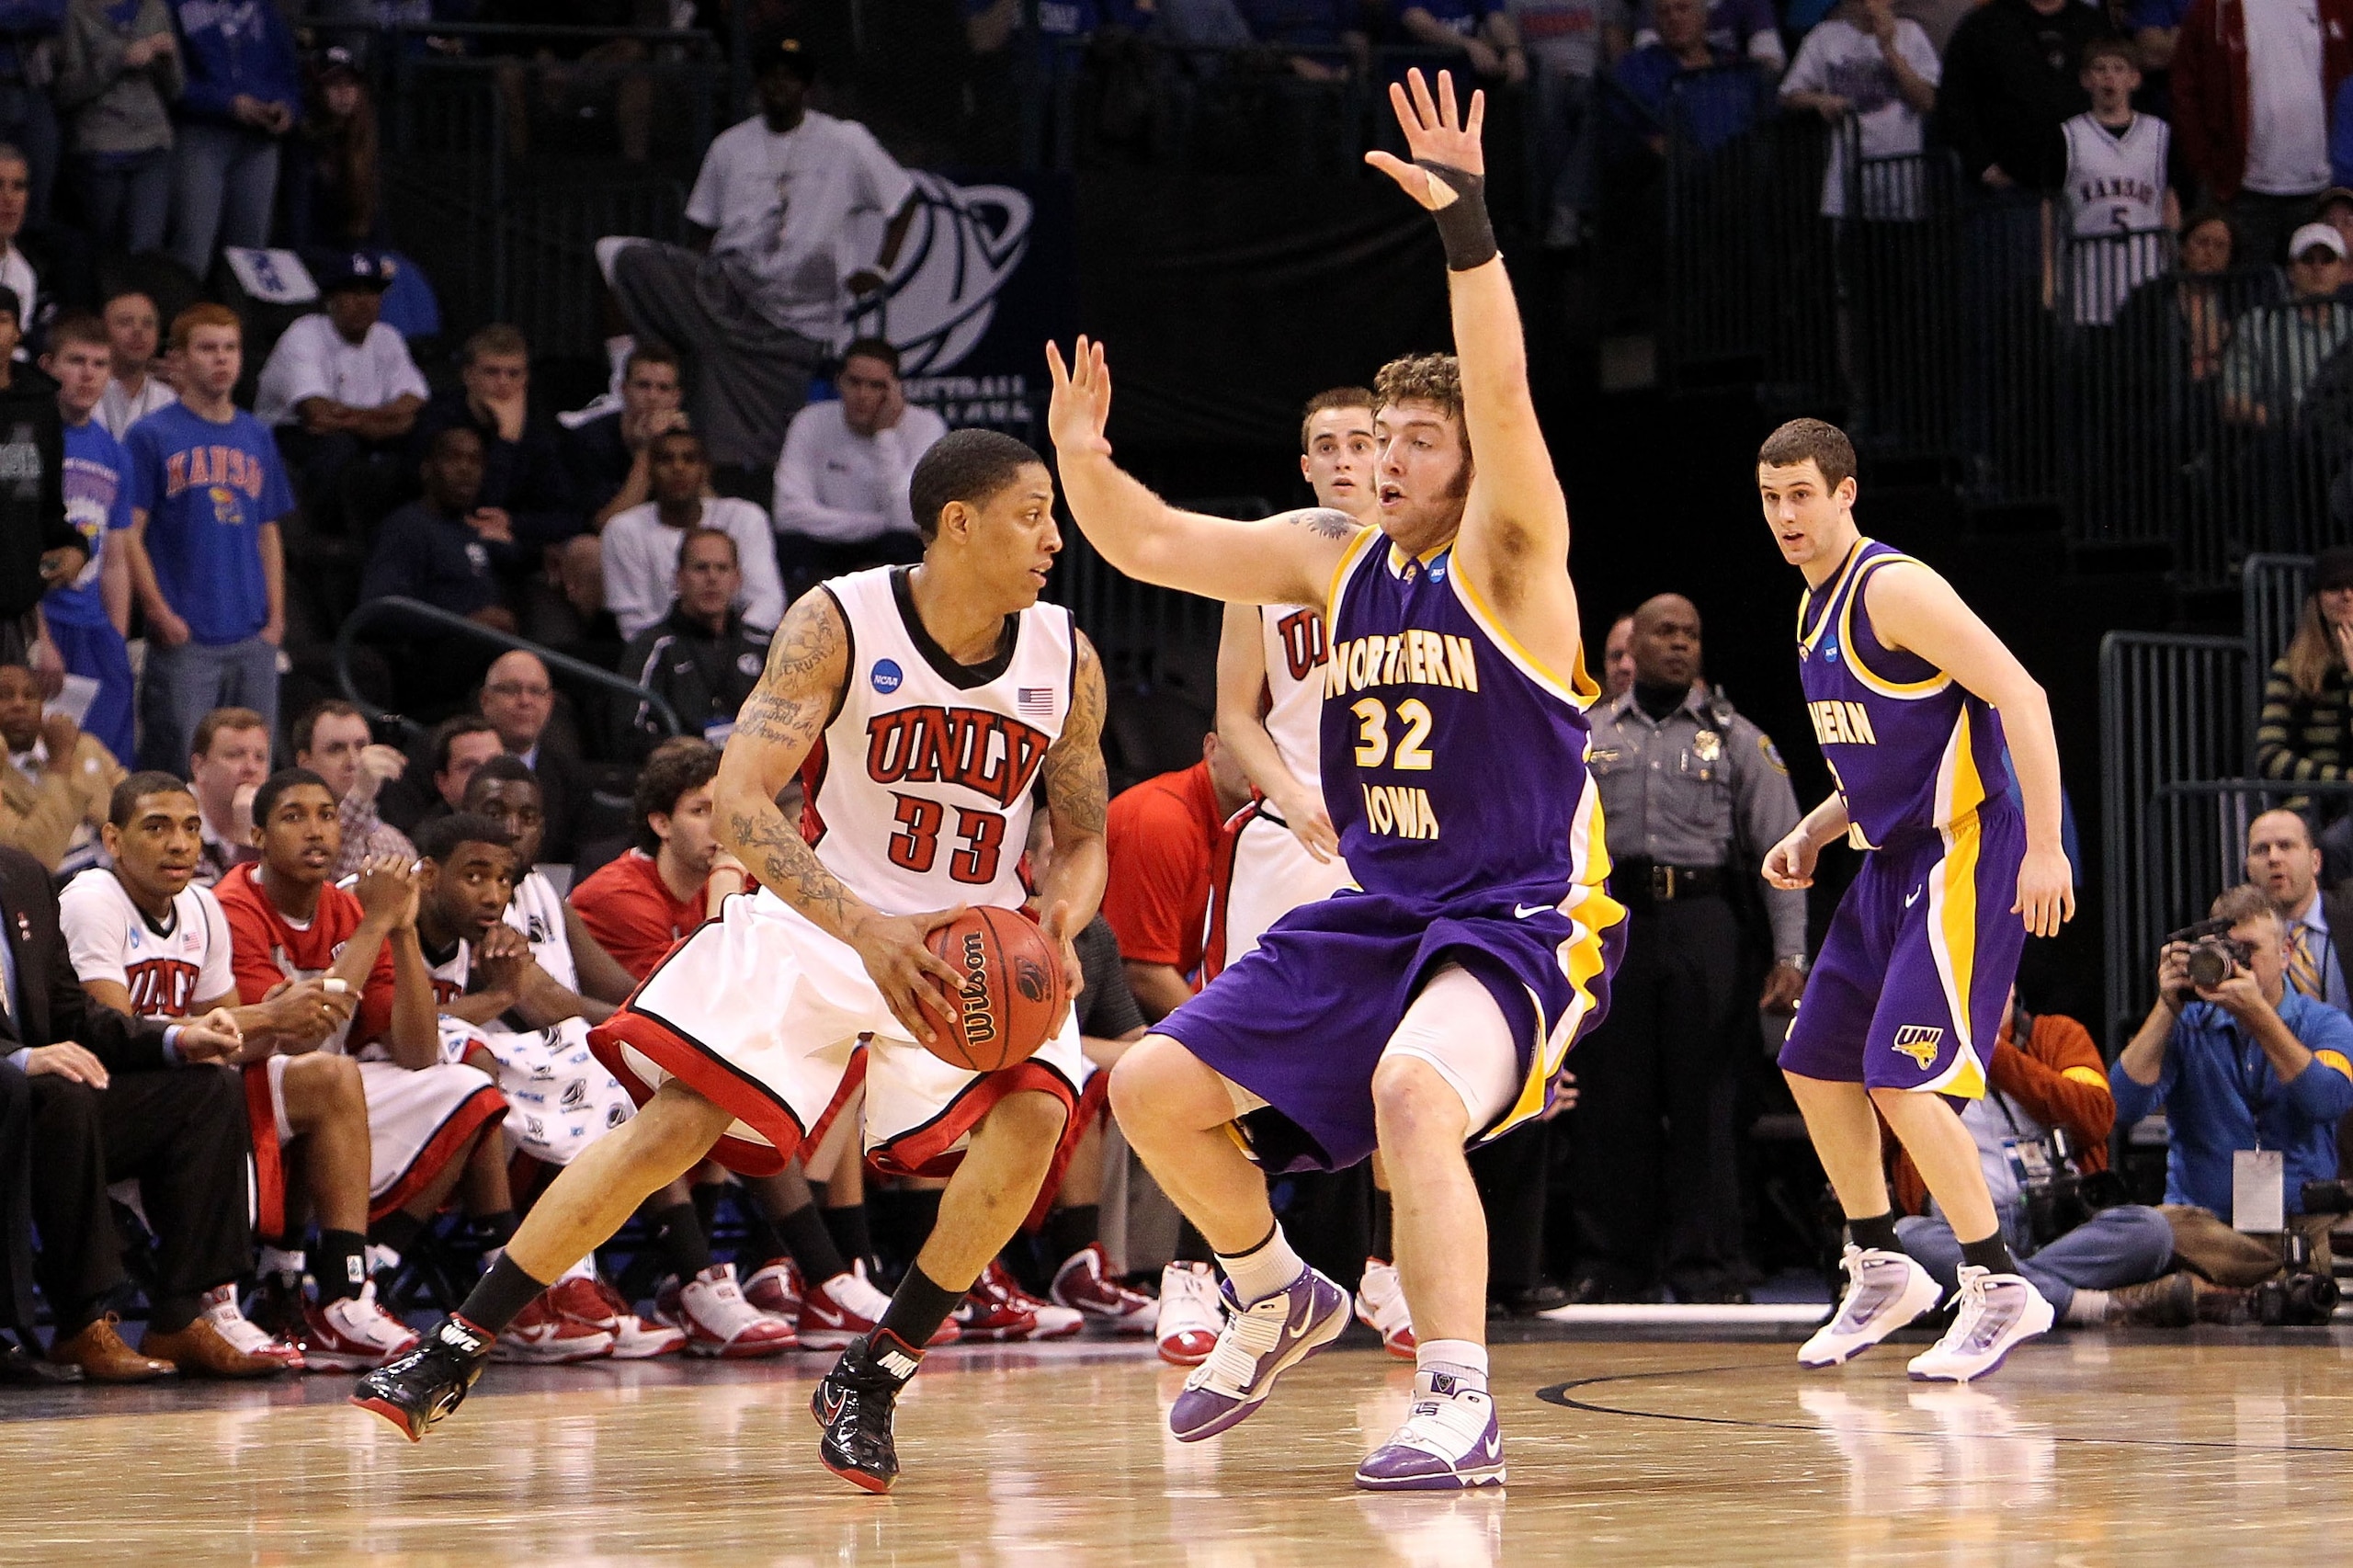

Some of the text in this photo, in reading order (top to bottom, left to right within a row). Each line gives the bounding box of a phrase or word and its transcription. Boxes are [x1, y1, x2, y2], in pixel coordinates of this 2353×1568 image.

[873, 674, 898, 687] NCAA
[1324, 629, 1479, 700] NORTHERN
[866, 706, 1051, 811] UNLV
[1350, 697, 1433, 770] 32
[887, 790, 1006, 884] 33
[1362, 783, 1439, 840] IOWA
[958, 931, 997, 1046] Wilson
[1896, 1028, 1941, 1046] UNI
